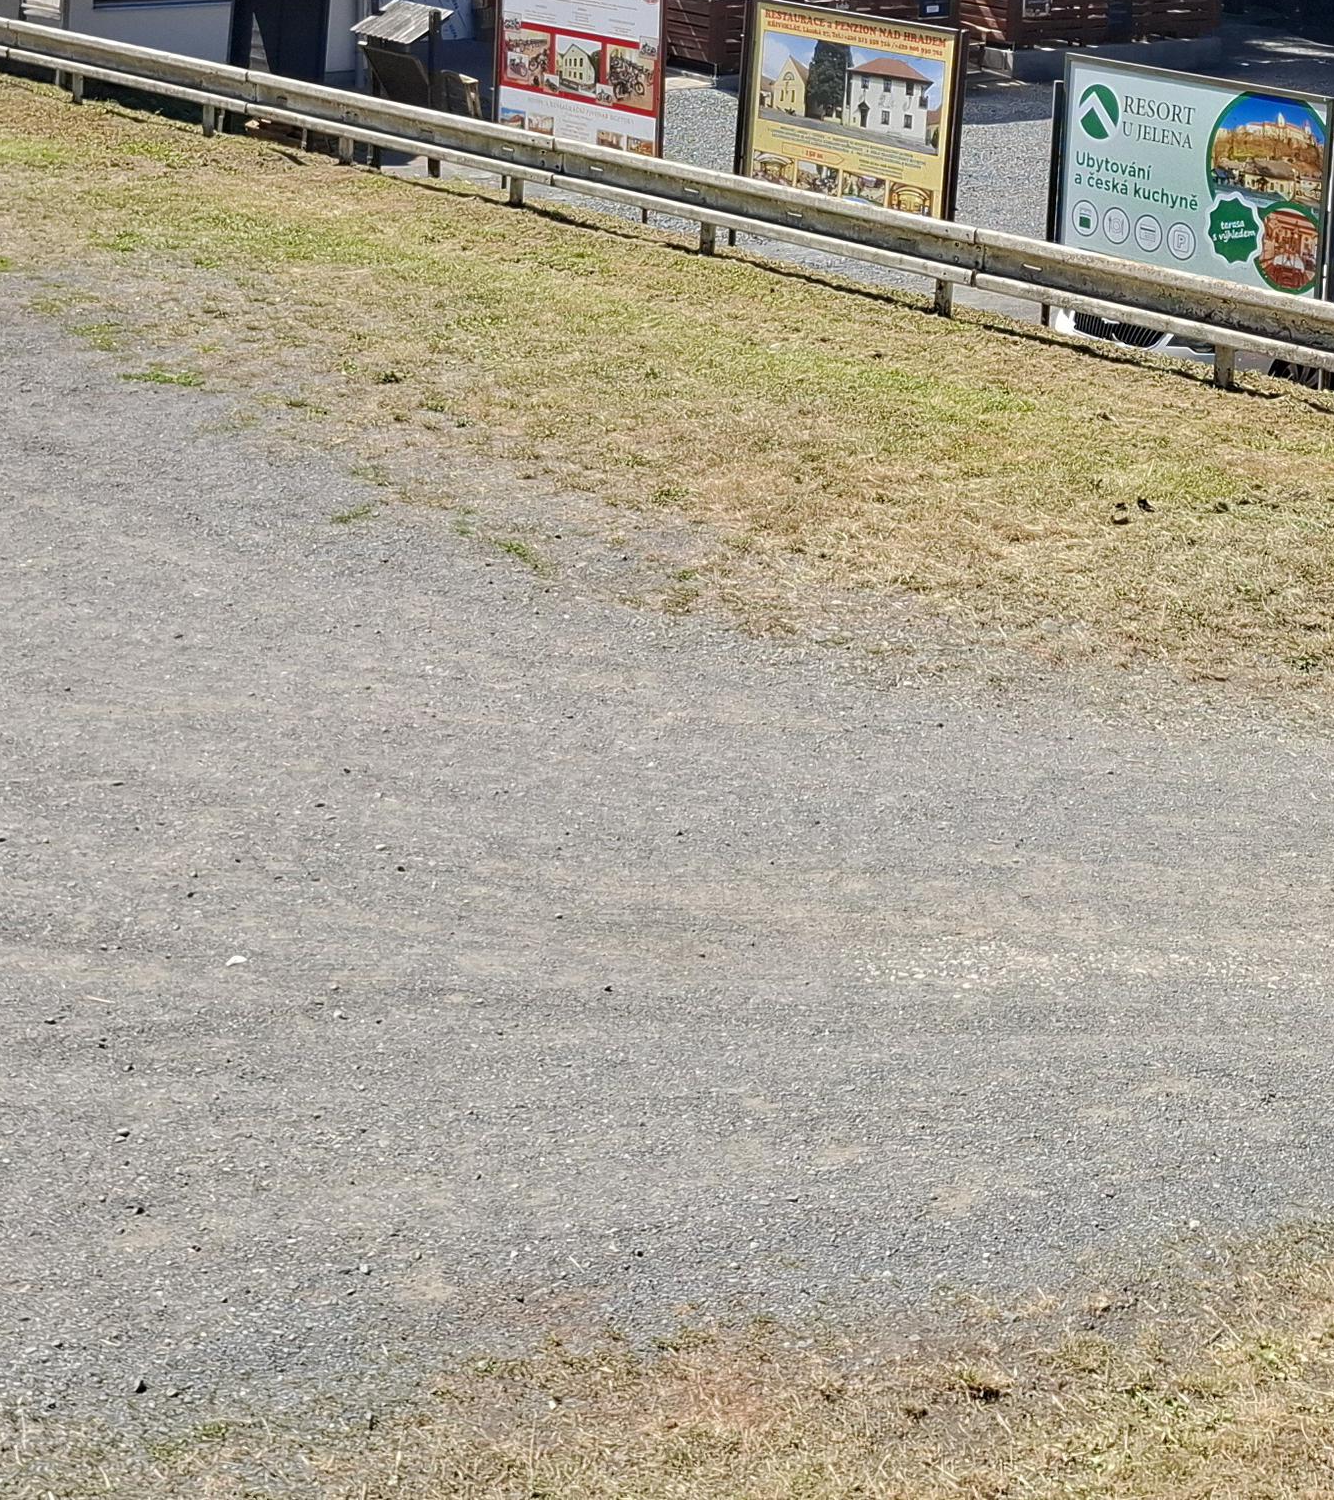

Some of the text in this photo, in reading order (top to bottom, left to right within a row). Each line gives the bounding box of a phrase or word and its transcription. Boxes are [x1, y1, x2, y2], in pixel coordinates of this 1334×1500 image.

[764, 8, 825, 27] RESTAURACE
[835, 20, 877, 35] PENZION
[879, 27, 900, 40] NAD
[903, 31, 946, 48] HRADEM
[1123, 95, 1196, 126] RESORT
[1122, 120, 1193, 149] U JELENA
[1075, 150, 1152, 181] Ubytování
[1074, 171, 1198, 211] a česká kuchyně
[1212, 228, 1256, 243] s výhledem
[1220, 220, 1245, 230] terasa
